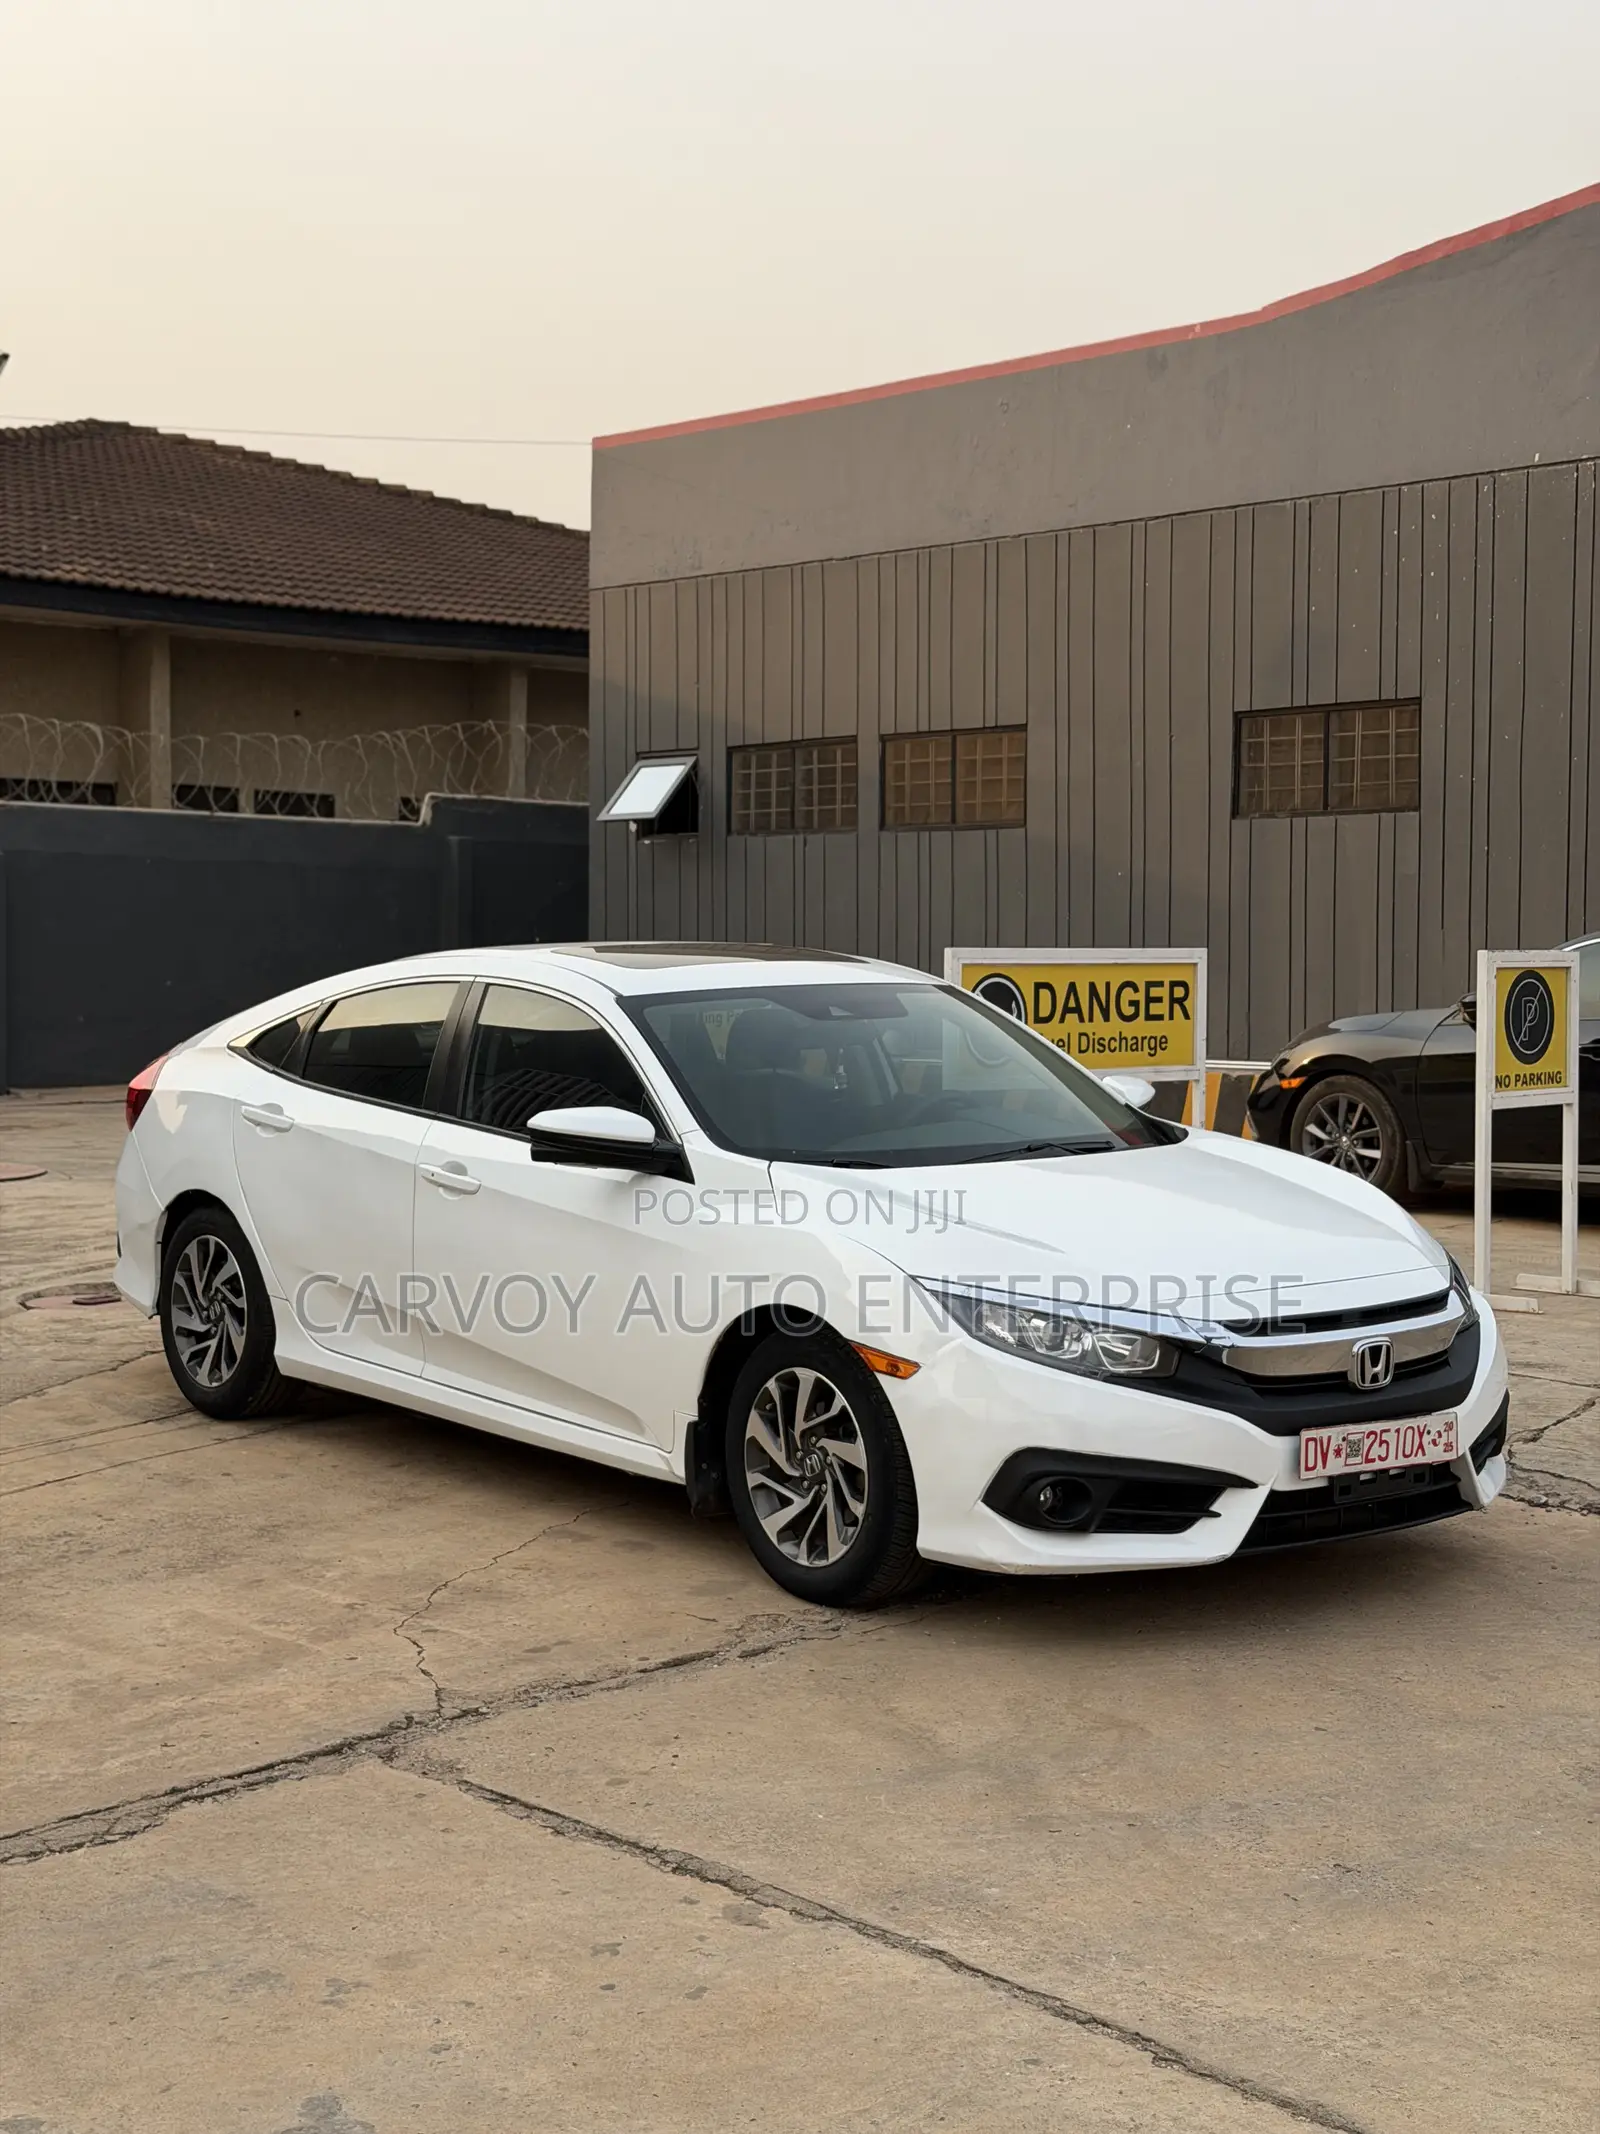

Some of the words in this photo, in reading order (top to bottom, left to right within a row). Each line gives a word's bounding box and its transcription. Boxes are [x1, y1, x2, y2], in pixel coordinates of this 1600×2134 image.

[1033, 980, 1191, 1025] DANGER
[1078, 1031, 1169, 1057] Discharge
[1495, 1074, 1511, 1089] NO
[1514, 1070, 1562, 1088] PARKING
[1304, 1435, 1332, 1472] DV
[1364, 1423, 1427, 1465] 2510X
